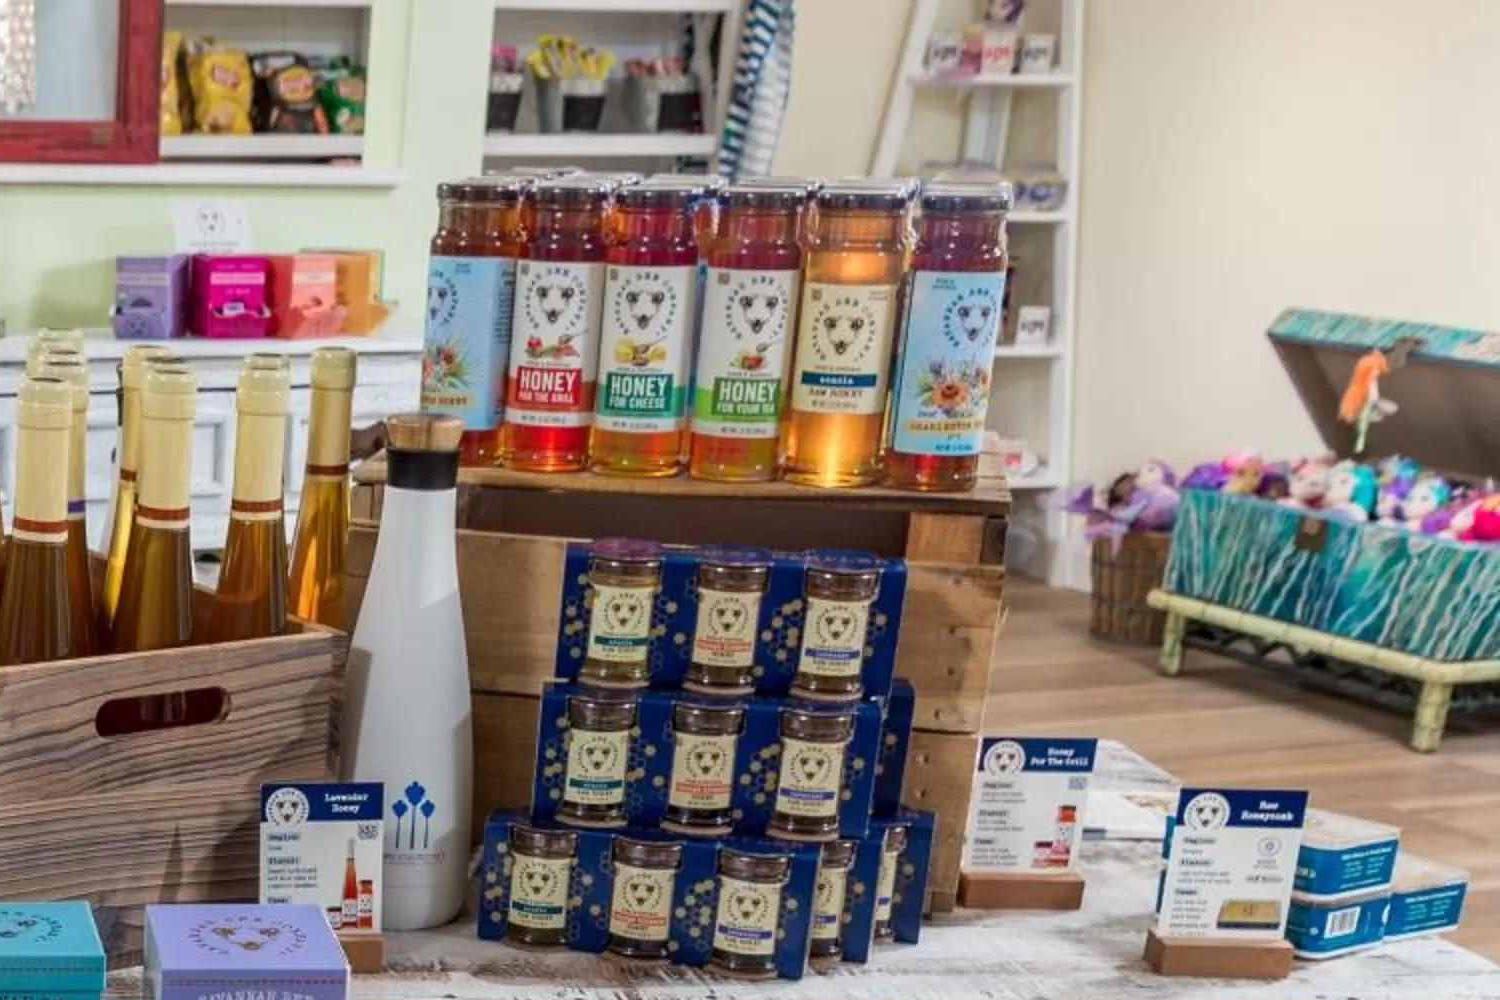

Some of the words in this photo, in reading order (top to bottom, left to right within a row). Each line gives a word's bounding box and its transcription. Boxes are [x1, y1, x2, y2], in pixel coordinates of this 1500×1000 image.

[520, 368, 576, 391] HONEY
[611, 375, 667, 397] HONEY
[719, 381, 777, 402] HONEY
